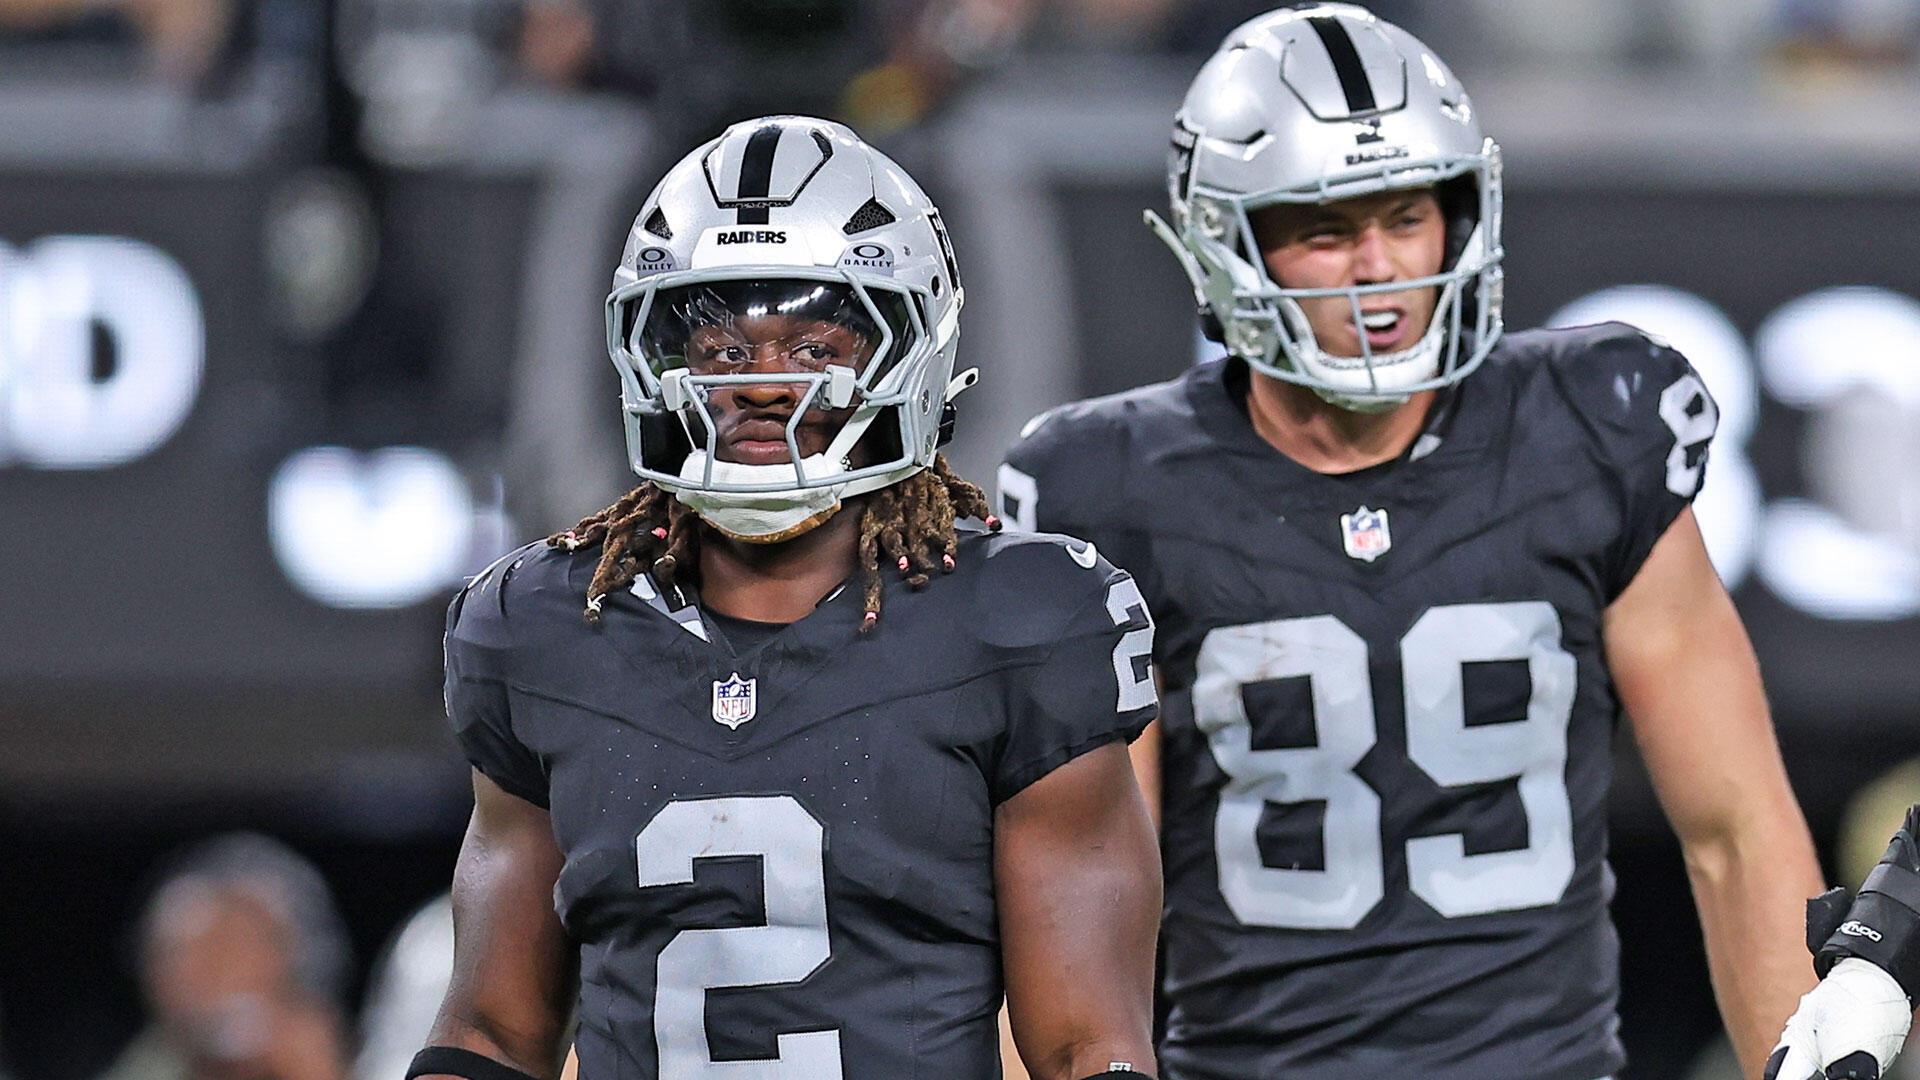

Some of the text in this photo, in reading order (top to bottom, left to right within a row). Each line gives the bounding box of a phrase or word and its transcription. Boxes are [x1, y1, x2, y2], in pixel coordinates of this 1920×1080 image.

[717, 231, 787, 245] RAIDERS
[844, 258, 892, 268] OAKLEY
[1105, 577, 1159, 713] 2
[720, 698, 748, 718] NFL
[1192, 601, 1578, 930] 89
[636, 796, 844, 1080] 2
